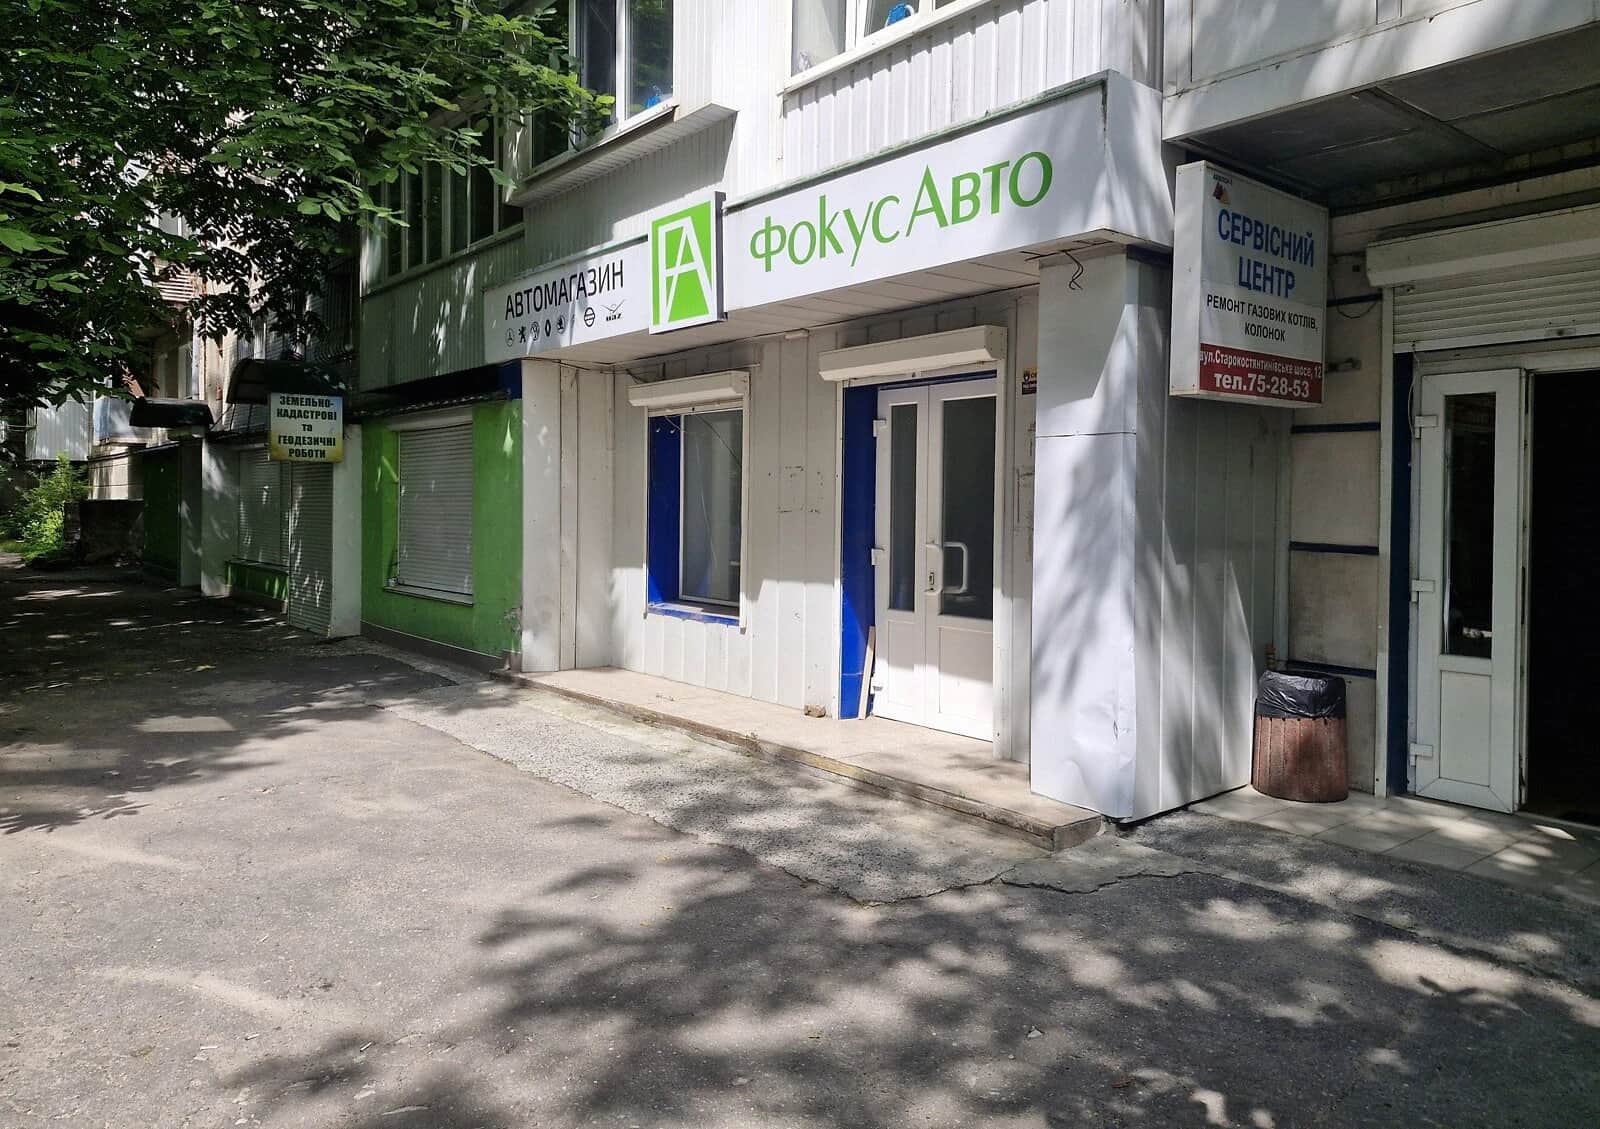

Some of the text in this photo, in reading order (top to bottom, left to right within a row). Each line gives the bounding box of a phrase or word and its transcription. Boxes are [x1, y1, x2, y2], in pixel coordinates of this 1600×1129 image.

[1218, 209, 1314, 267] СЕРВІСНИЙ
[1238, 256, 1295, 298] ЦЕНТР
[505, 260, 624, 320] АВТОМАГАЗИН
[1207, 294, 1319, 332] РЕМОНТ ГАЗОВИХ КОТЛІВ,
[1245, 322, 1286, 341] КОЛОНОК
[280, 396, 334, 408] ЗЕМЕЛЬНО-
[277, 408, 336, 420] КАДАСТРОВІ
[278, 435, 336, 446] ГЕОДЕЗИЧНІ
[289, 448, 326, 458] РОБОТИ
